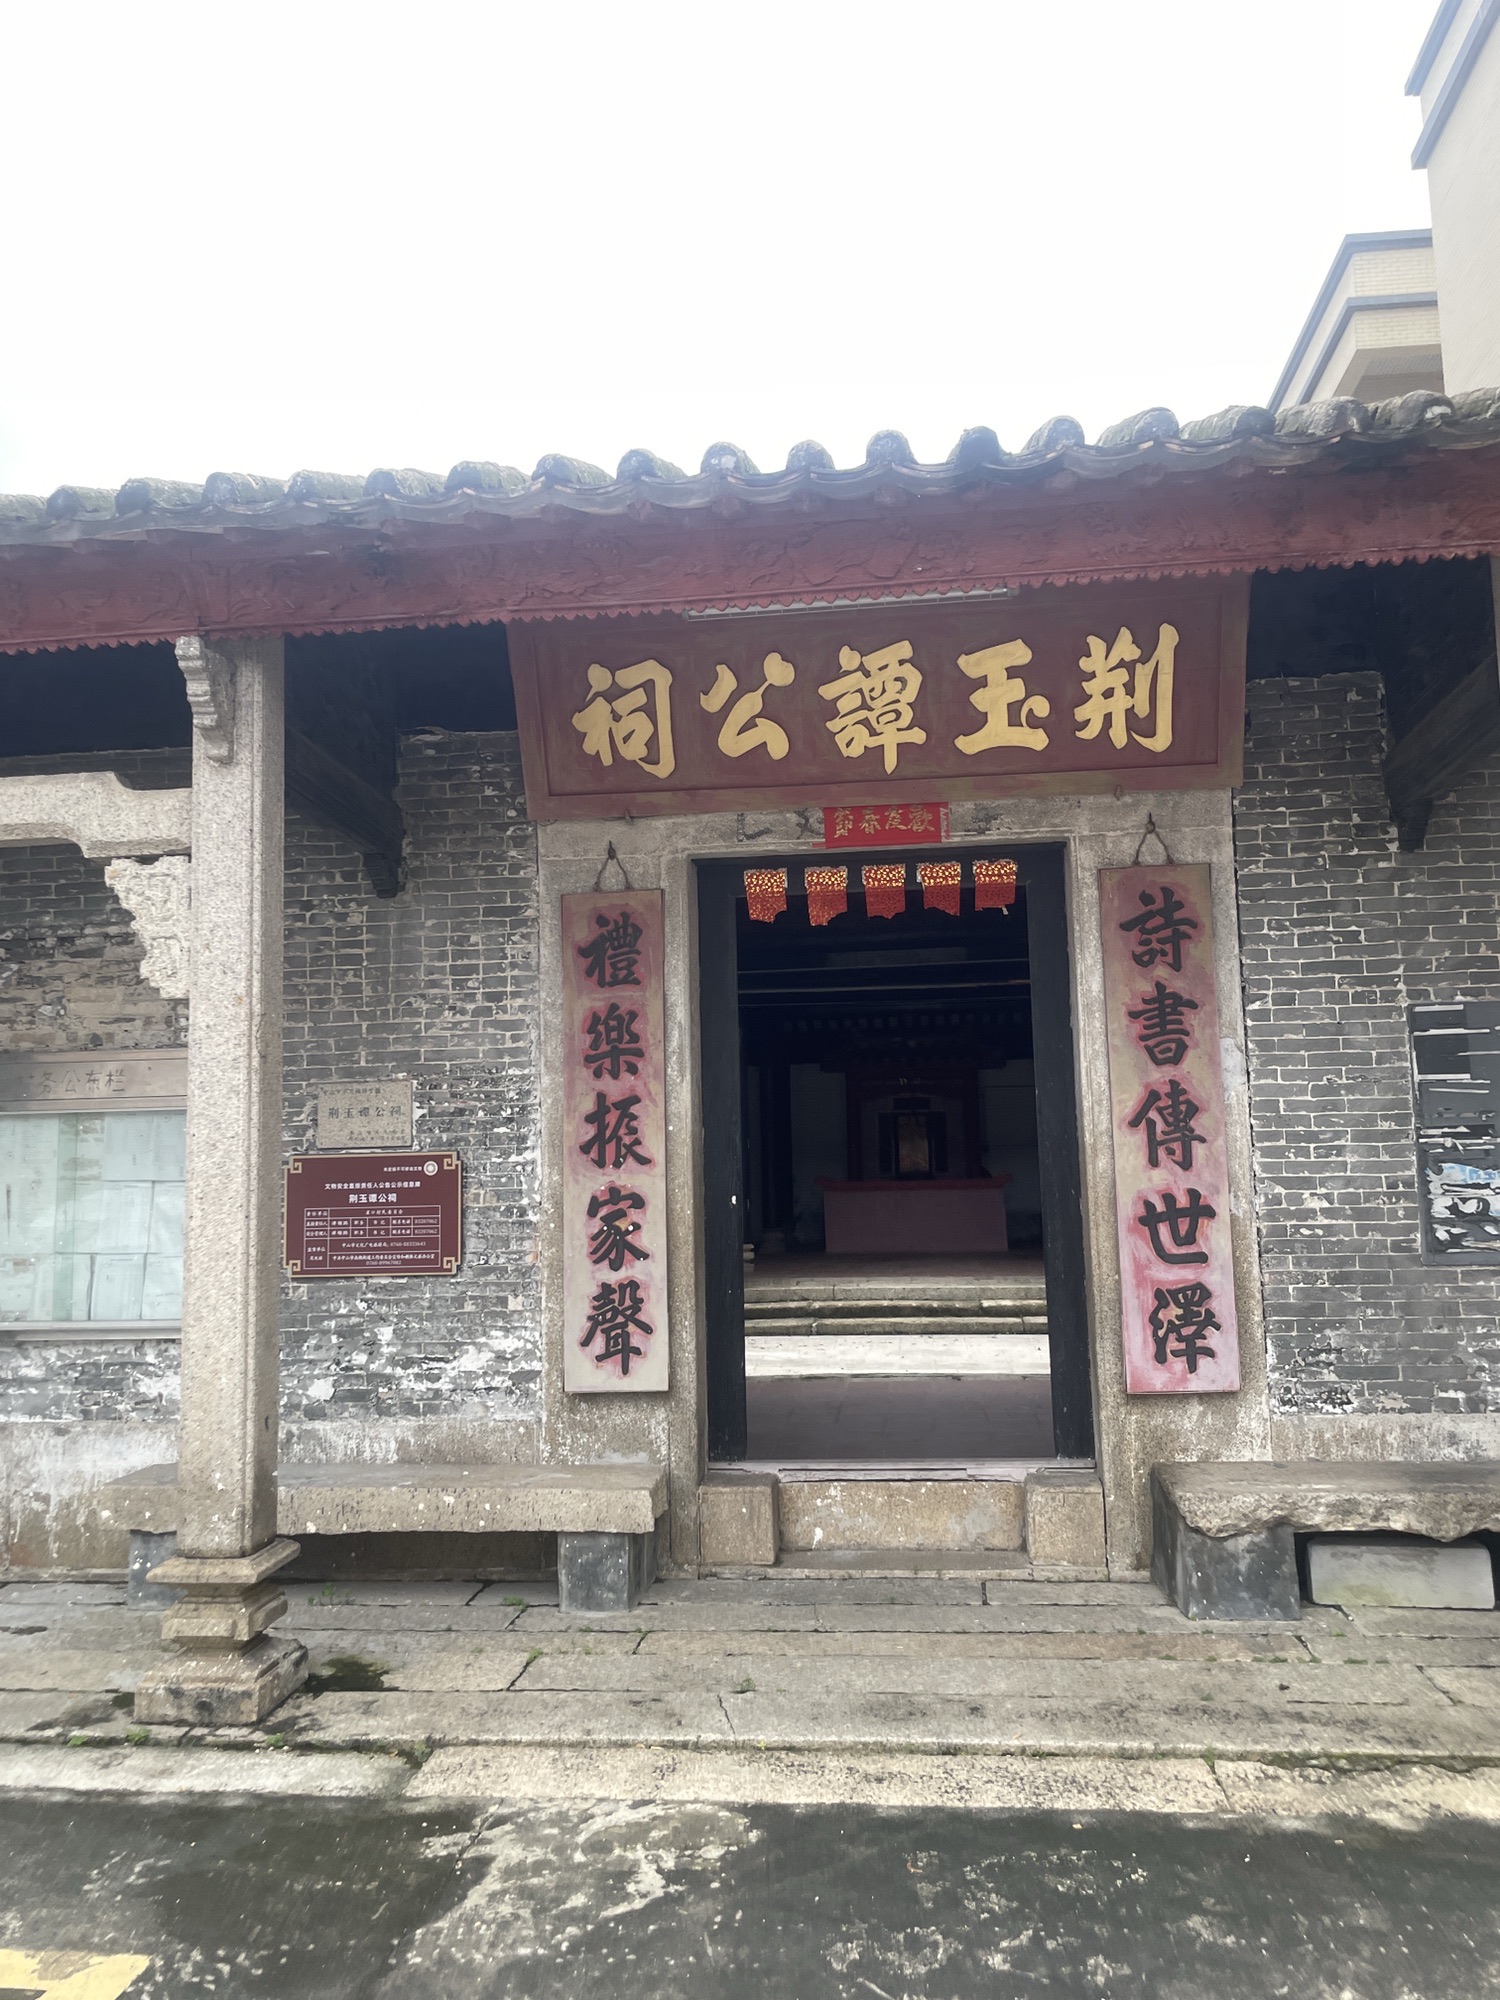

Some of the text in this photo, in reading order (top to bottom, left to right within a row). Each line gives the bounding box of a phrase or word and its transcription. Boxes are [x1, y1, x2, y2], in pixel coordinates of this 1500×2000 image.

[17, 1068, 125, 1095] 务公布栏
[328, 1105, 402, 1119] 荆玉谭公祠
[348, 1193, 398, 1204] 荆玉谭公祠
